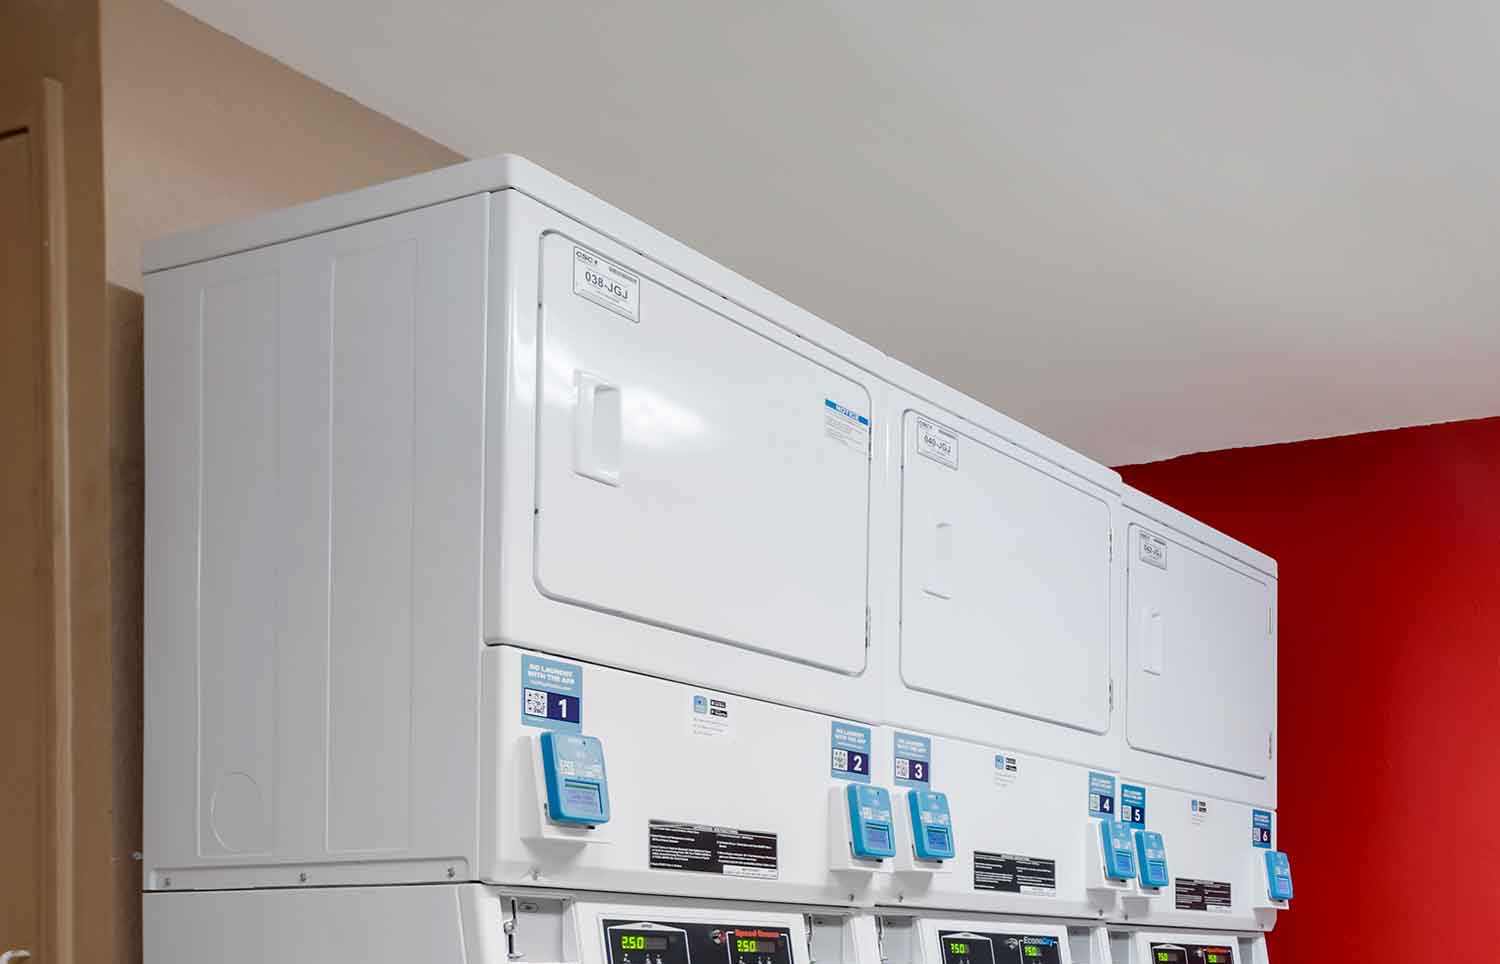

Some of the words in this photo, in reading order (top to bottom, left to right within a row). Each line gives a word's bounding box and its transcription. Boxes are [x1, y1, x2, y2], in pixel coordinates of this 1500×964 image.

[585, 271, 628, 299] 038-JGJ
[558, 698, 567, 719] 1
[853, 755, 863, 772] 2
[914, 763, 923, 779] 3
[1103, 798, 1110, 811] 4
[1134, 808, 1141, 821] 5
[1262, 831, 1268, 841] 6
